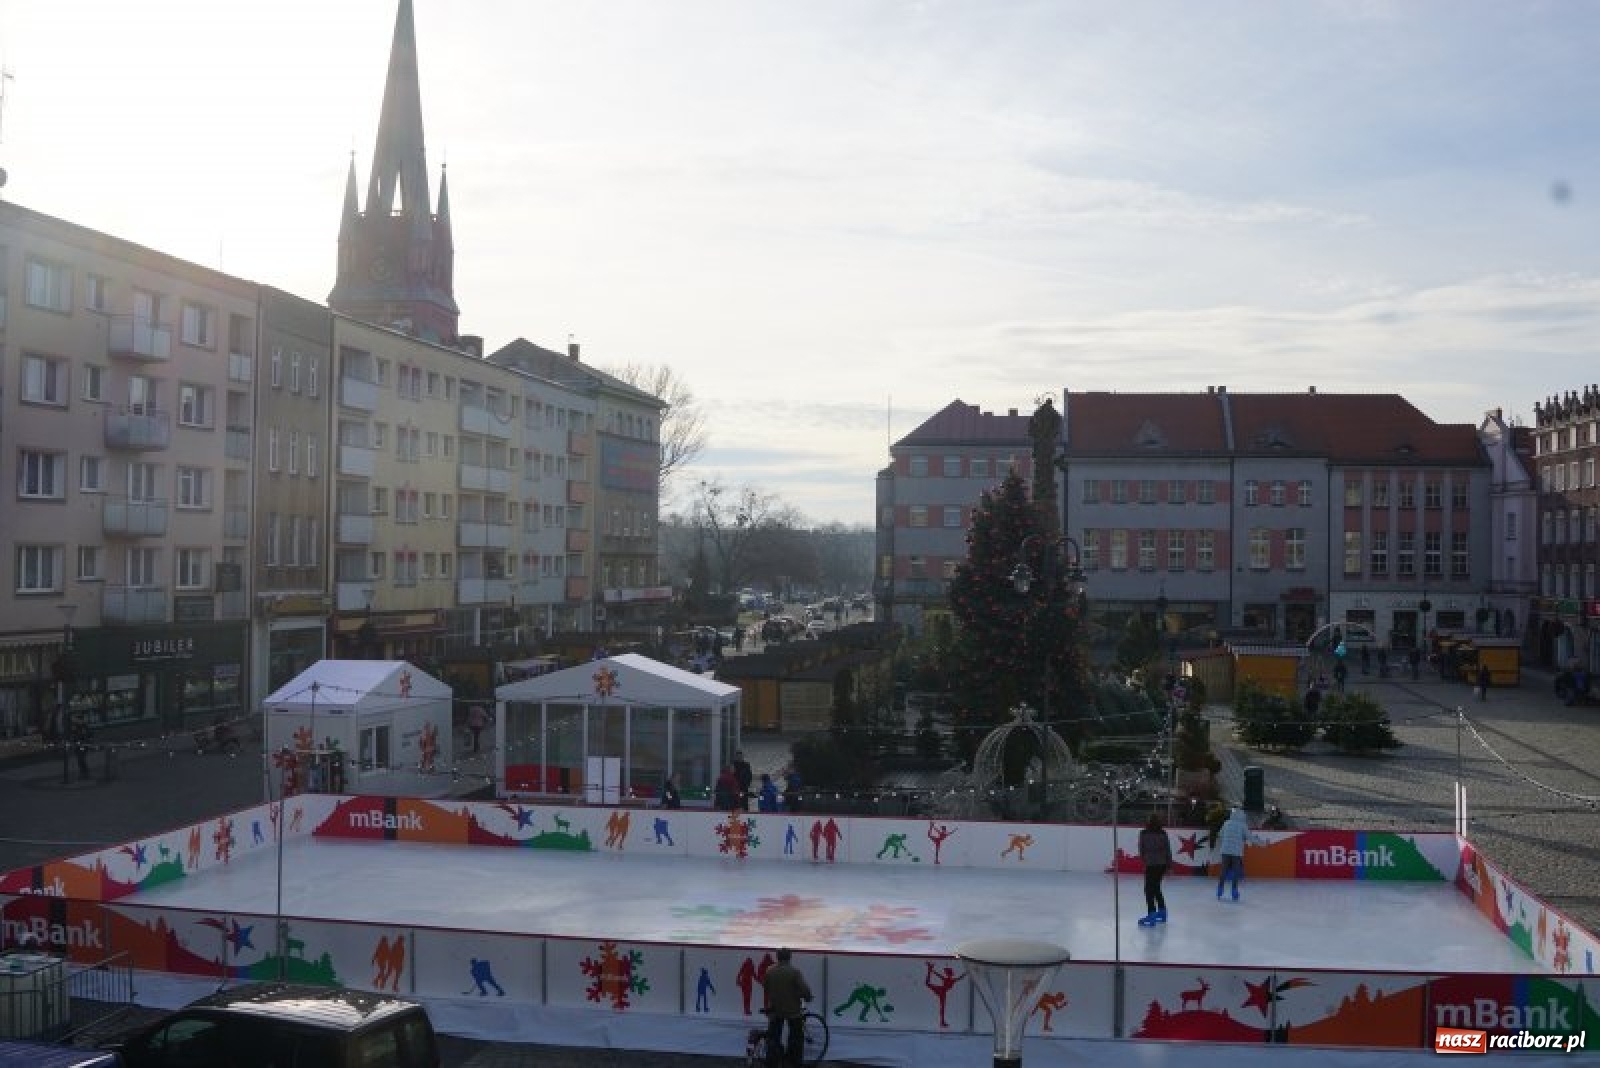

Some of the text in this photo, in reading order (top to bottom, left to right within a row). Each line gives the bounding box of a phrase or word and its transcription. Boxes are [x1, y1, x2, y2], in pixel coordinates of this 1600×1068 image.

[349, 809, 424, 831] mBank
[1304, 844, 1396, 867] mBank
[1435, 998, 1574, 1030] mBank
